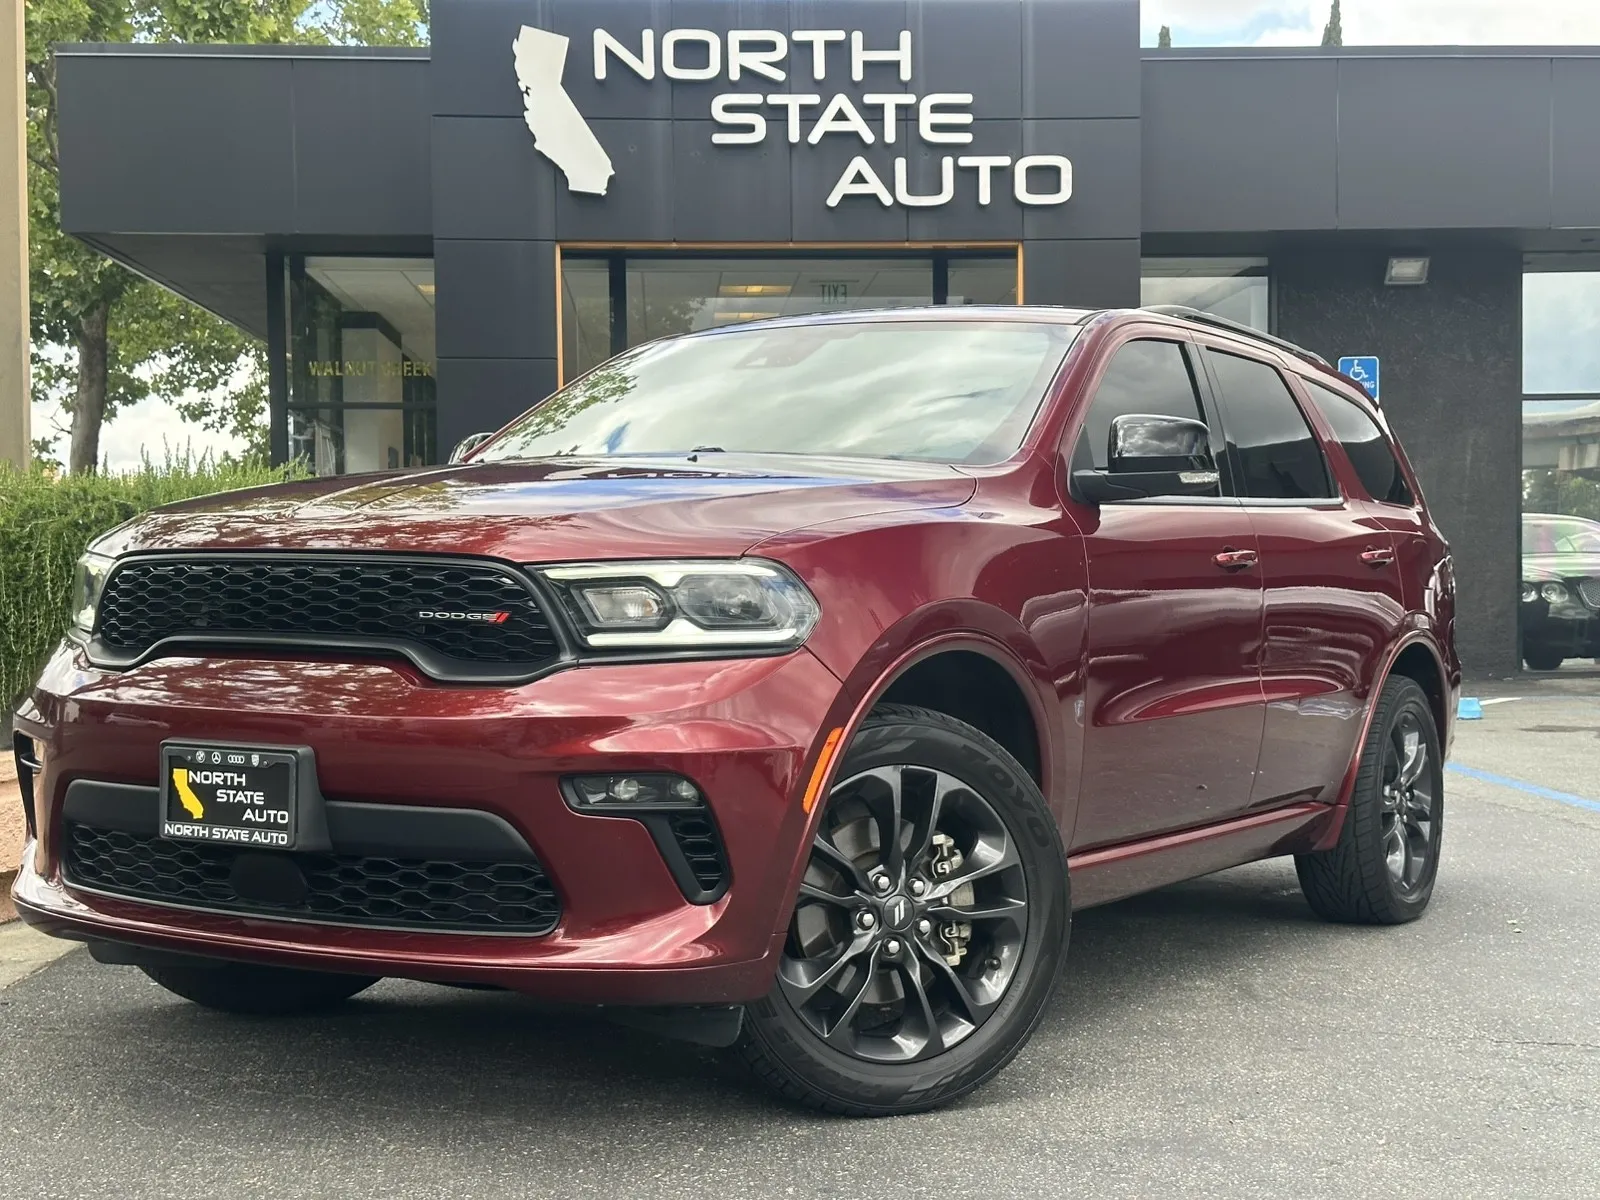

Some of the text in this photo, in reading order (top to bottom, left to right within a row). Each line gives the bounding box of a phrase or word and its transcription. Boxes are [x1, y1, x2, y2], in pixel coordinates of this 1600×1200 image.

[593, 28, 911, 82] NORTH
[711, 93, 973, 145] STATE
[826, 155, 1073, 207] AUTO
[308, 360, 376, 377] WALNUT
[419, 611, 497, 621] DODGE
[188, 770, 246, 786] NORTH
[216, 789, 264, 804] STATE
[961, 743, 1051, 848] TOYO
[242, 808, 288, 824] AUTO
[164, 823, 287, 845] NORTH STATE AUTO
